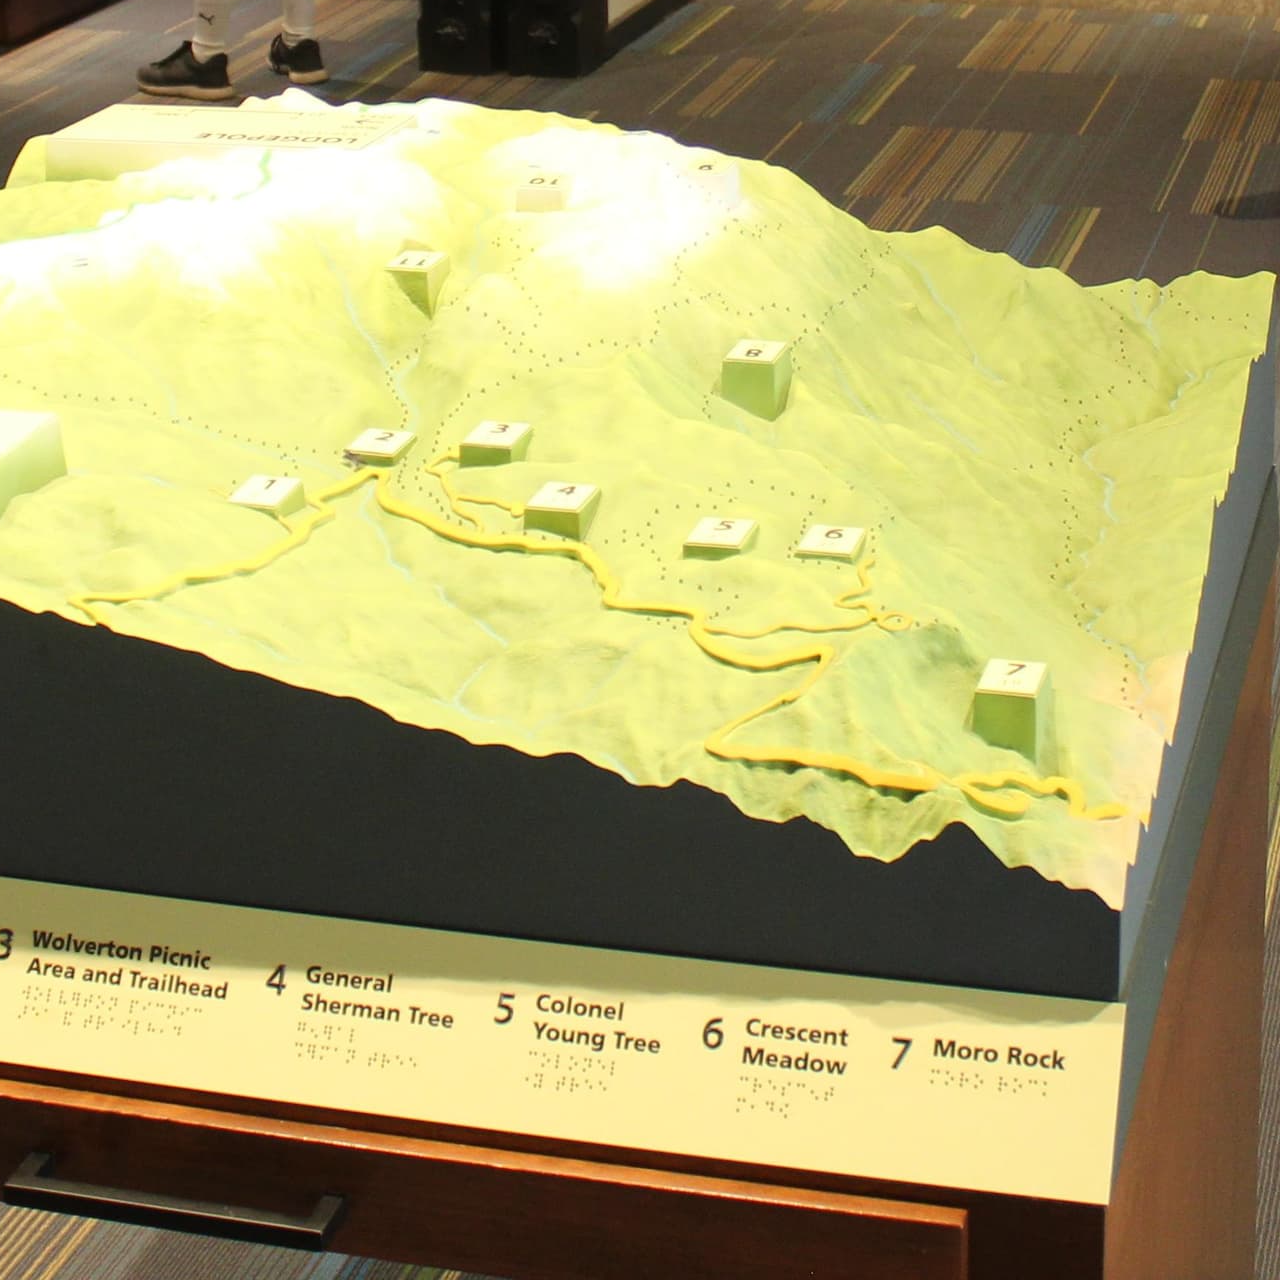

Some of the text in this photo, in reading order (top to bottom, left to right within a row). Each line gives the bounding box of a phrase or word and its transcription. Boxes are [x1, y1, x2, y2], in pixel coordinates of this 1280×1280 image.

[1008, 663, 1026, 676] 7
[32, 929, 143, 962] Wolverton
[149, 945, 211, 970] Picnic
[26, 957, 228, 1000] Area and Trailhead
[266, 964, 393, 996] 4 General
[301, 993, 454, 1028] Sherman Tree
[494, 992, 624, 1025] 5 Colonel
[533, 1022, 661, 1054] Young Tree
[702, 1017, 849, 1049] 6 Crescent
[742, 1046, 848, 1075] Meadow
[891, 1036, 1066, 1070] 7 Moro Rock
